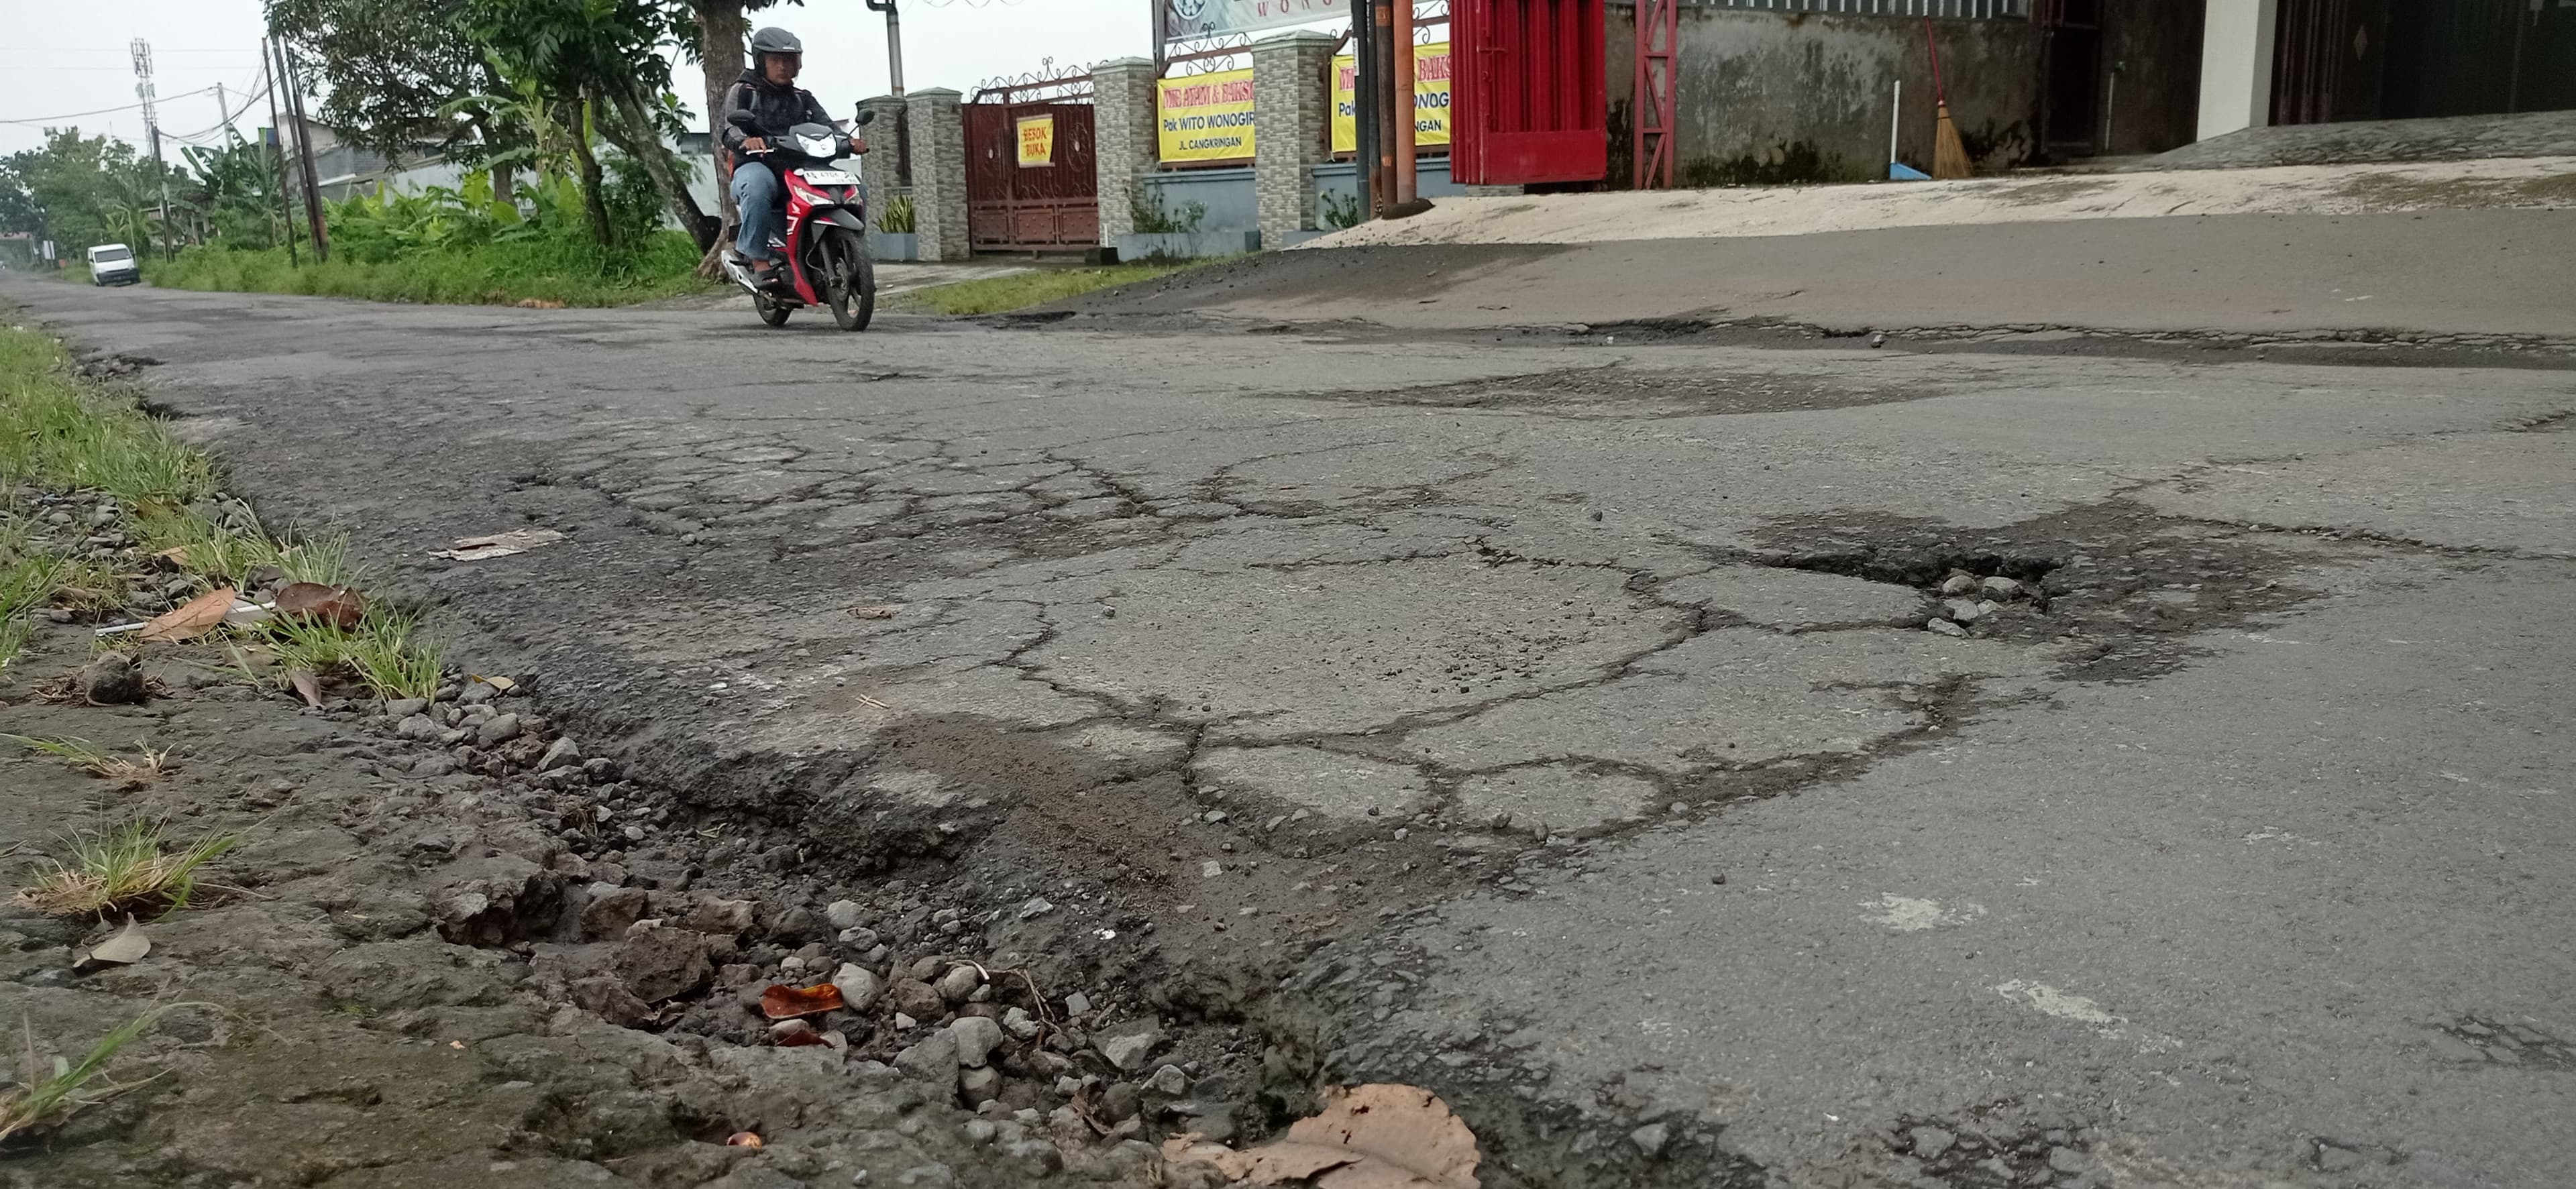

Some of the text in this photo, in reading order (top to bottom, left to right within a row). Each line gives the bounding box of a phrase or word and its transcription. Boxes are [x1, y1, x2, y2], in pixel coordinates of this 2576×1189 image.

[1164, 118, 1177, 131] Pak
[1179, 116, 1205, 131] WITO
[1024, 127, 1047, 141] BESOK
[1026, 142, 1046, 156] BUKA
[1189, 136, 1242, 150] CANGKRINGAN
